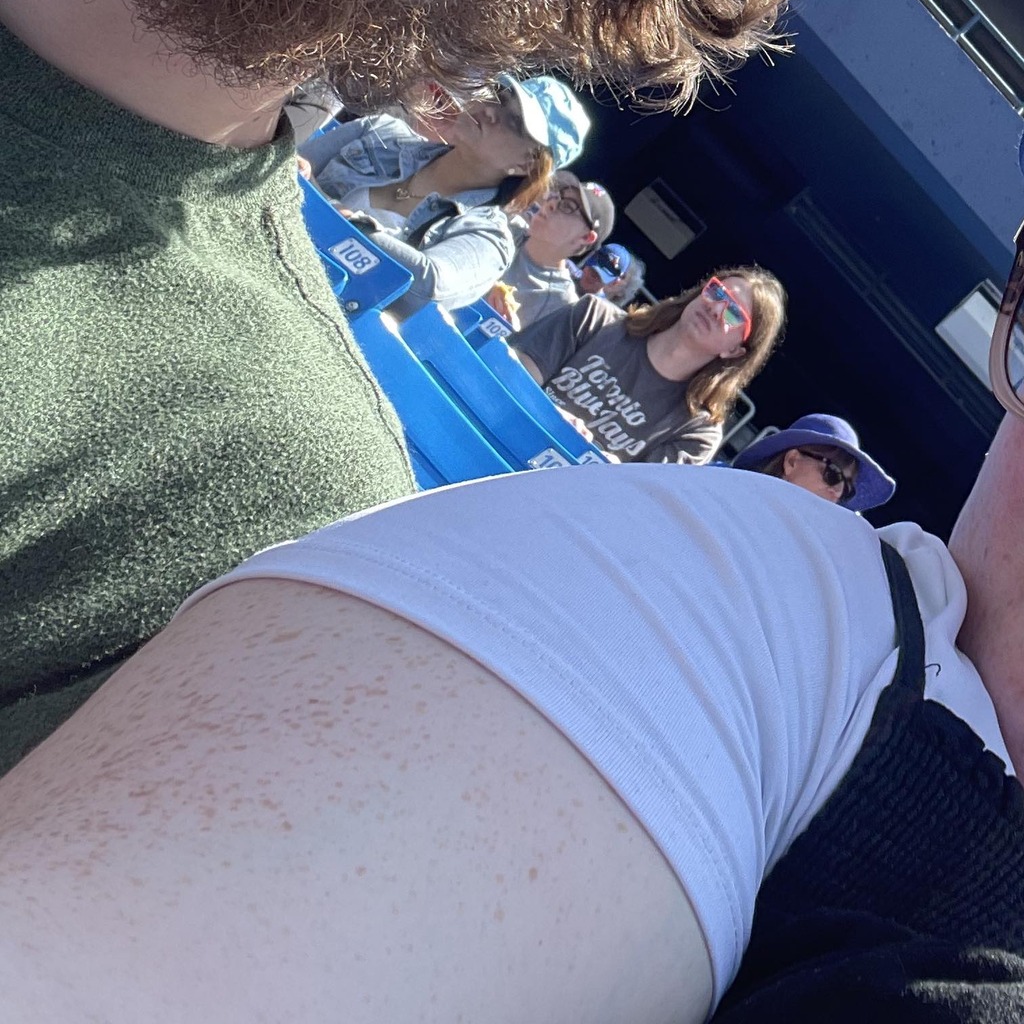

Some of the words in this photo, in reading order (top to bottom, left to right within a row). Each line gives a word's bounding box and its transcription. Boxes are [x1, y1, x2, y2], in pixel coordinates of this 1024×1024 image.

[338, 244, 372, 269] 108
[552, 367, 604, 416] Blue
[587, 409, 647, 456] Jays
